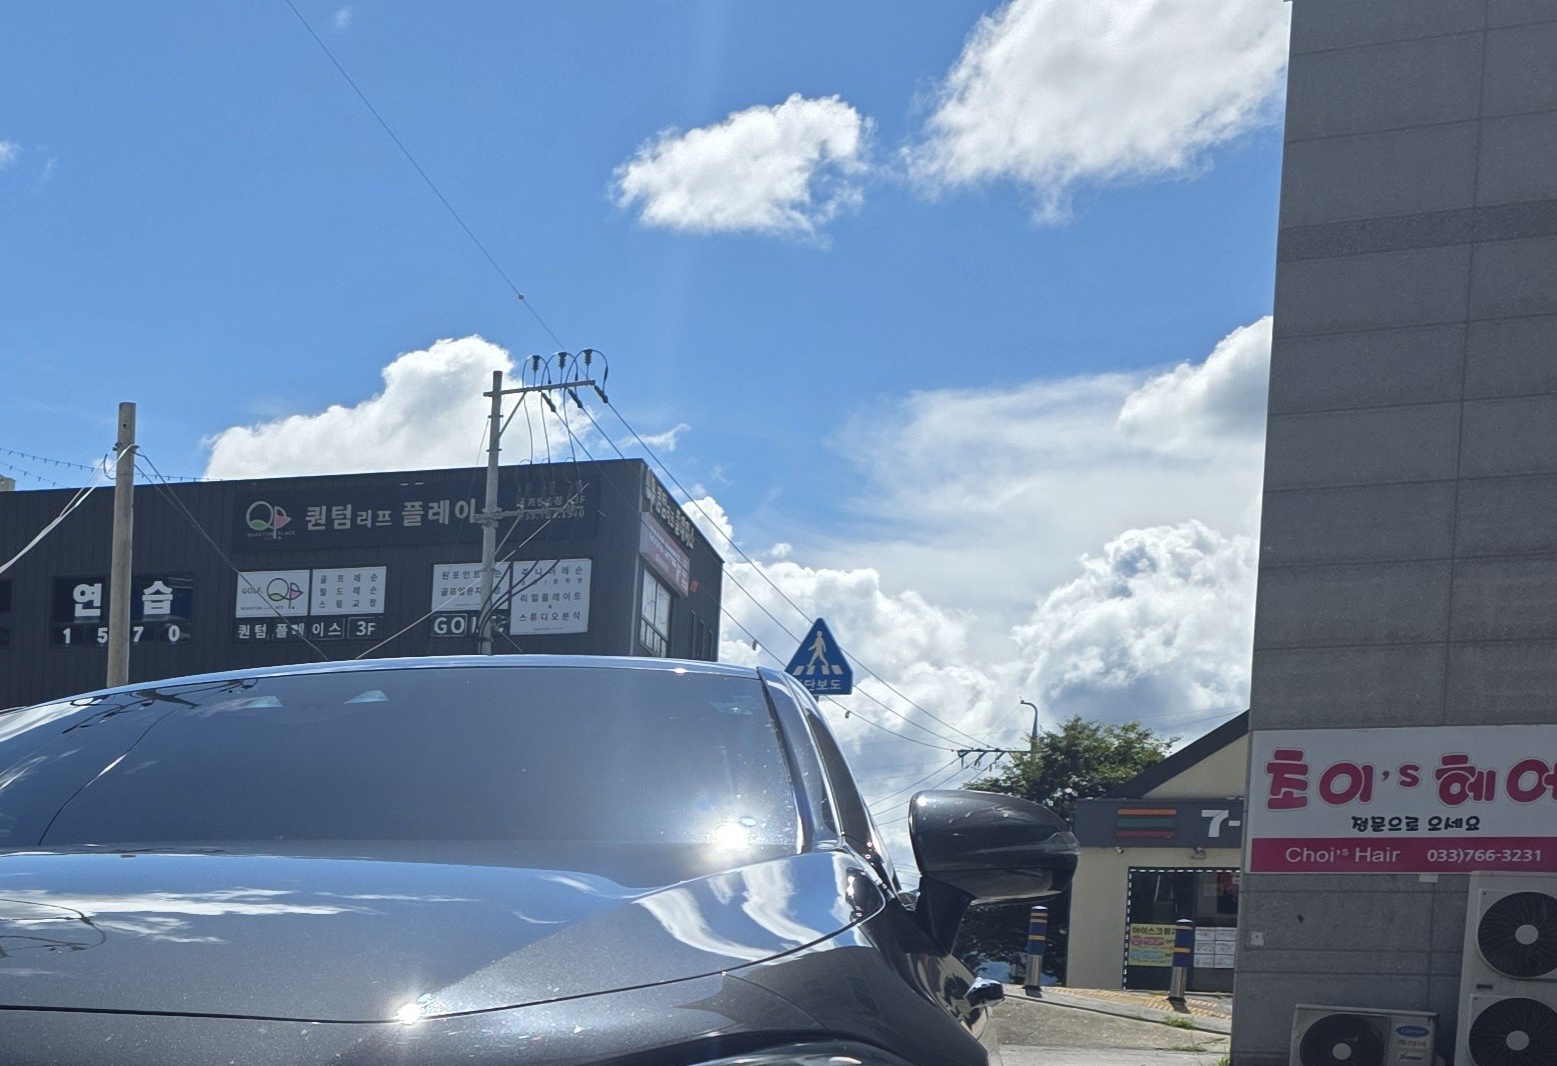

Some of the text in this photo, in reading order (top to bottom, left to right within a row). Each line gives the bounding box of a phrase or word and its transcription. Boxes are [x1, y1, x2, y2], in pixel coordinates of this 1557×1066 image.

[401, 498, 478, 527] 플레이
[356, 620, 376, 636] 3F
[433, 616, 492, 635] GOL
[802, 679, 842, 691] 단보도
[1351, 815, 1481, 832] 정문으로 오세요
[1355, 847, 1401, 863] Hair
[1427, 848, 1542, 864] 033)766-3231
